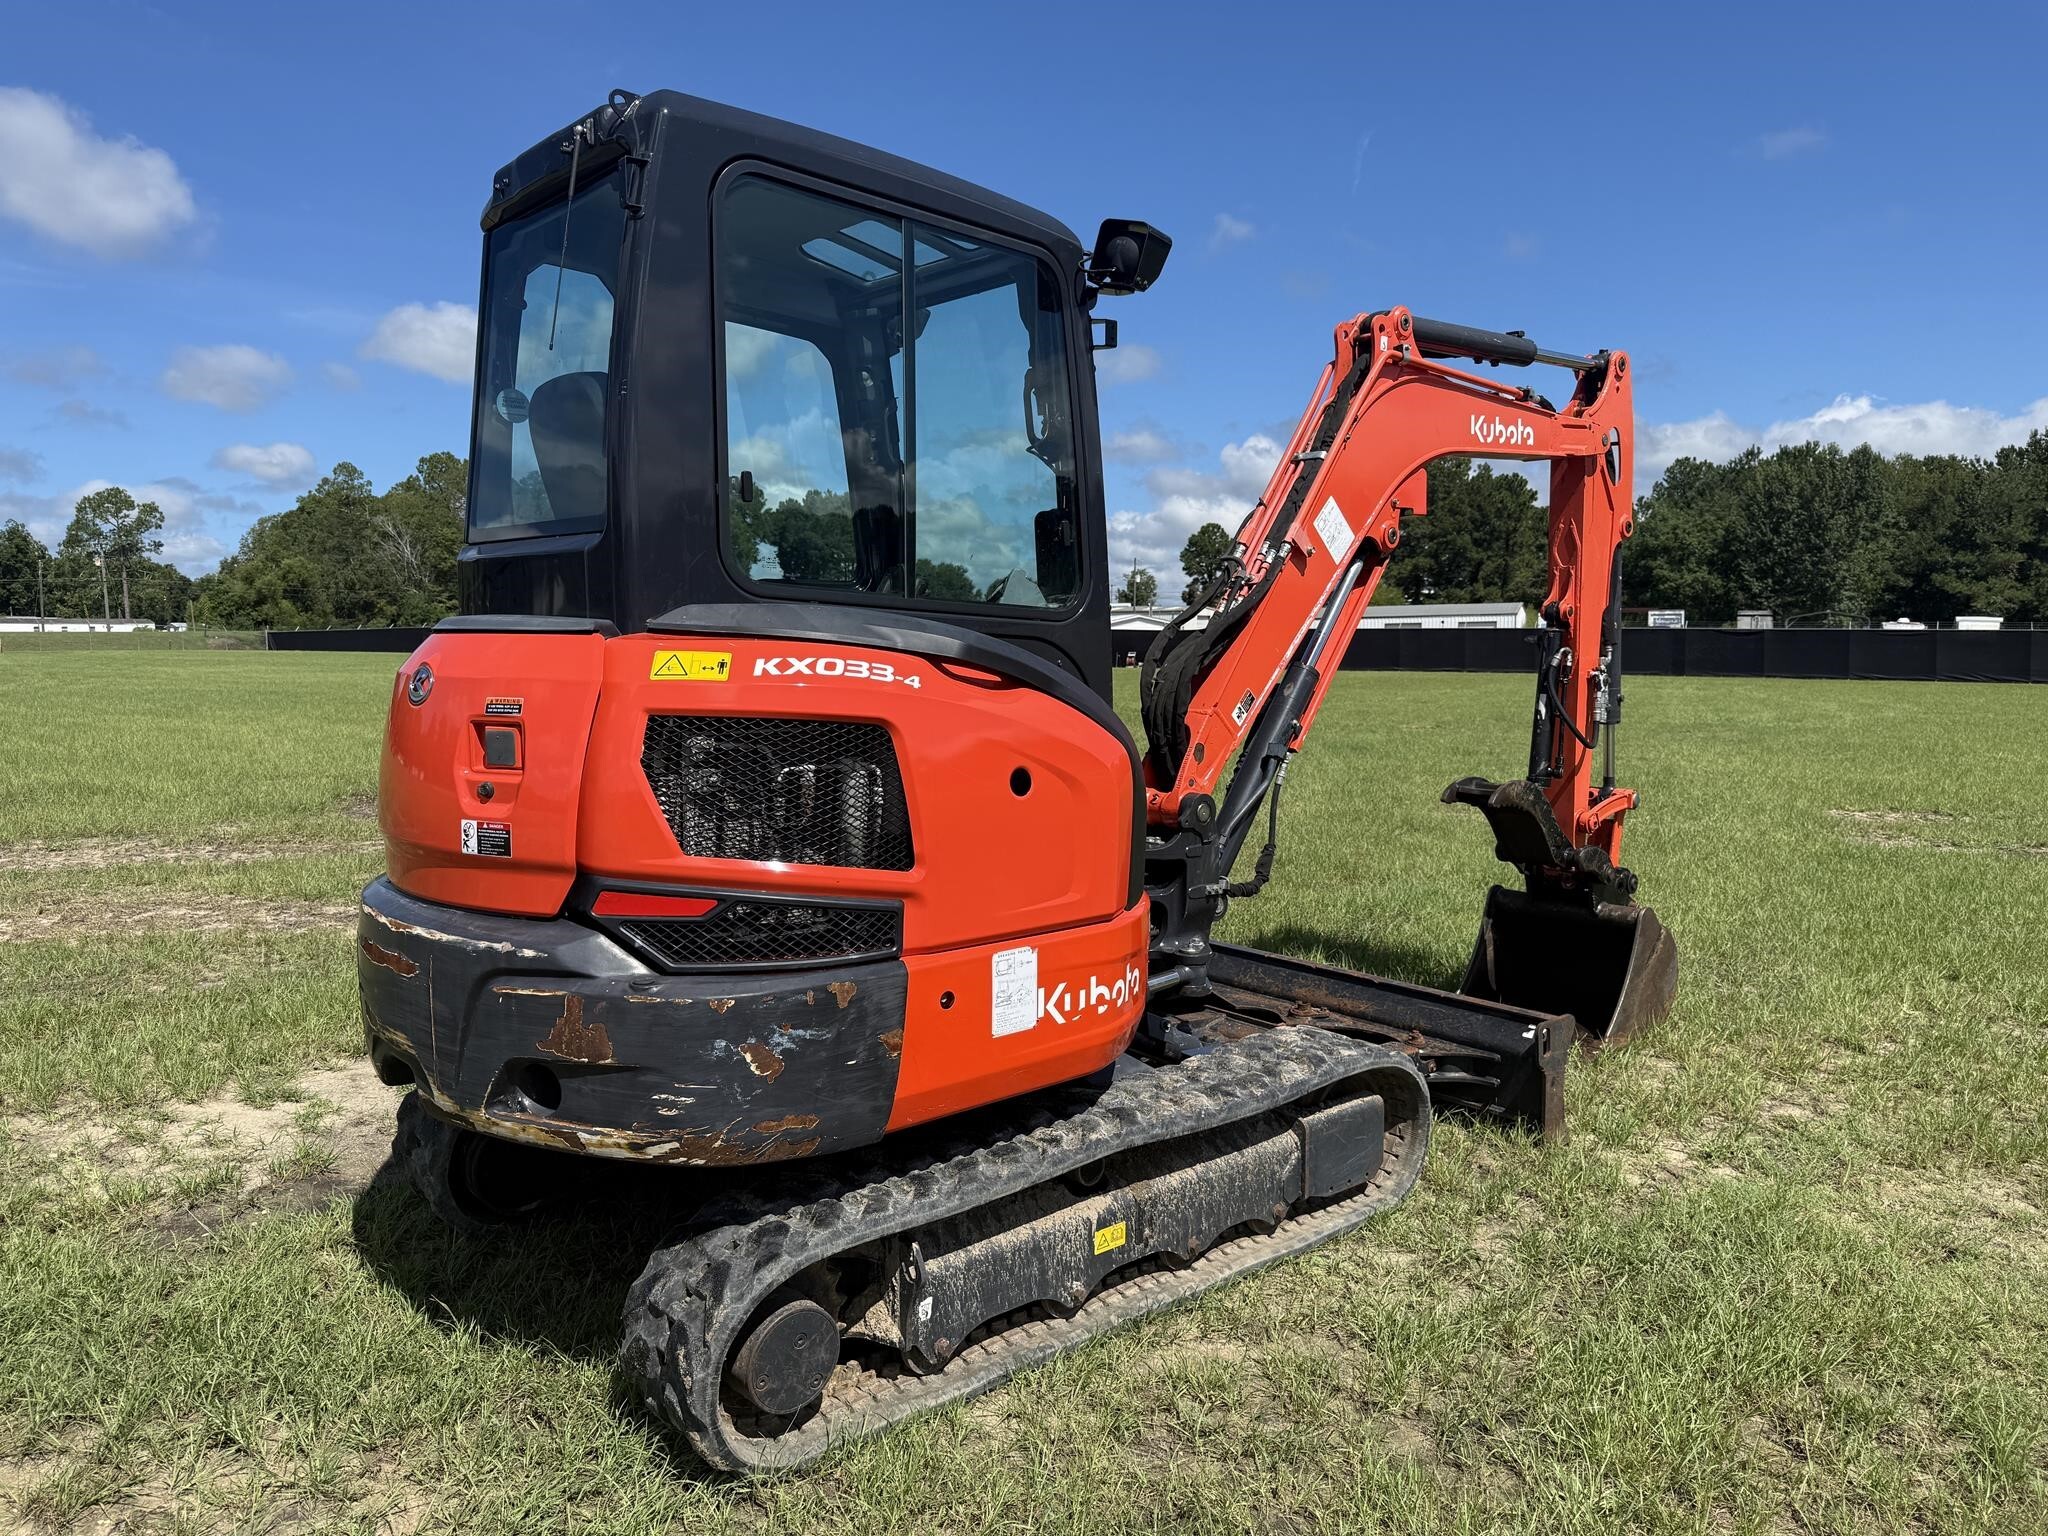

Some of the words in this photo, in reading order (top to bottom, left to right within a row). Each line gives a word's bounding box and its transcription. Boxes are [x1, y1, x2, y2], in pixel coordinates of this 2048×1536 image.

[1470, 414, 1535, 446] Kubota
[752, 657, 922, 689] KX033-4
[1037, 962, 1140, 1025] Kubota
